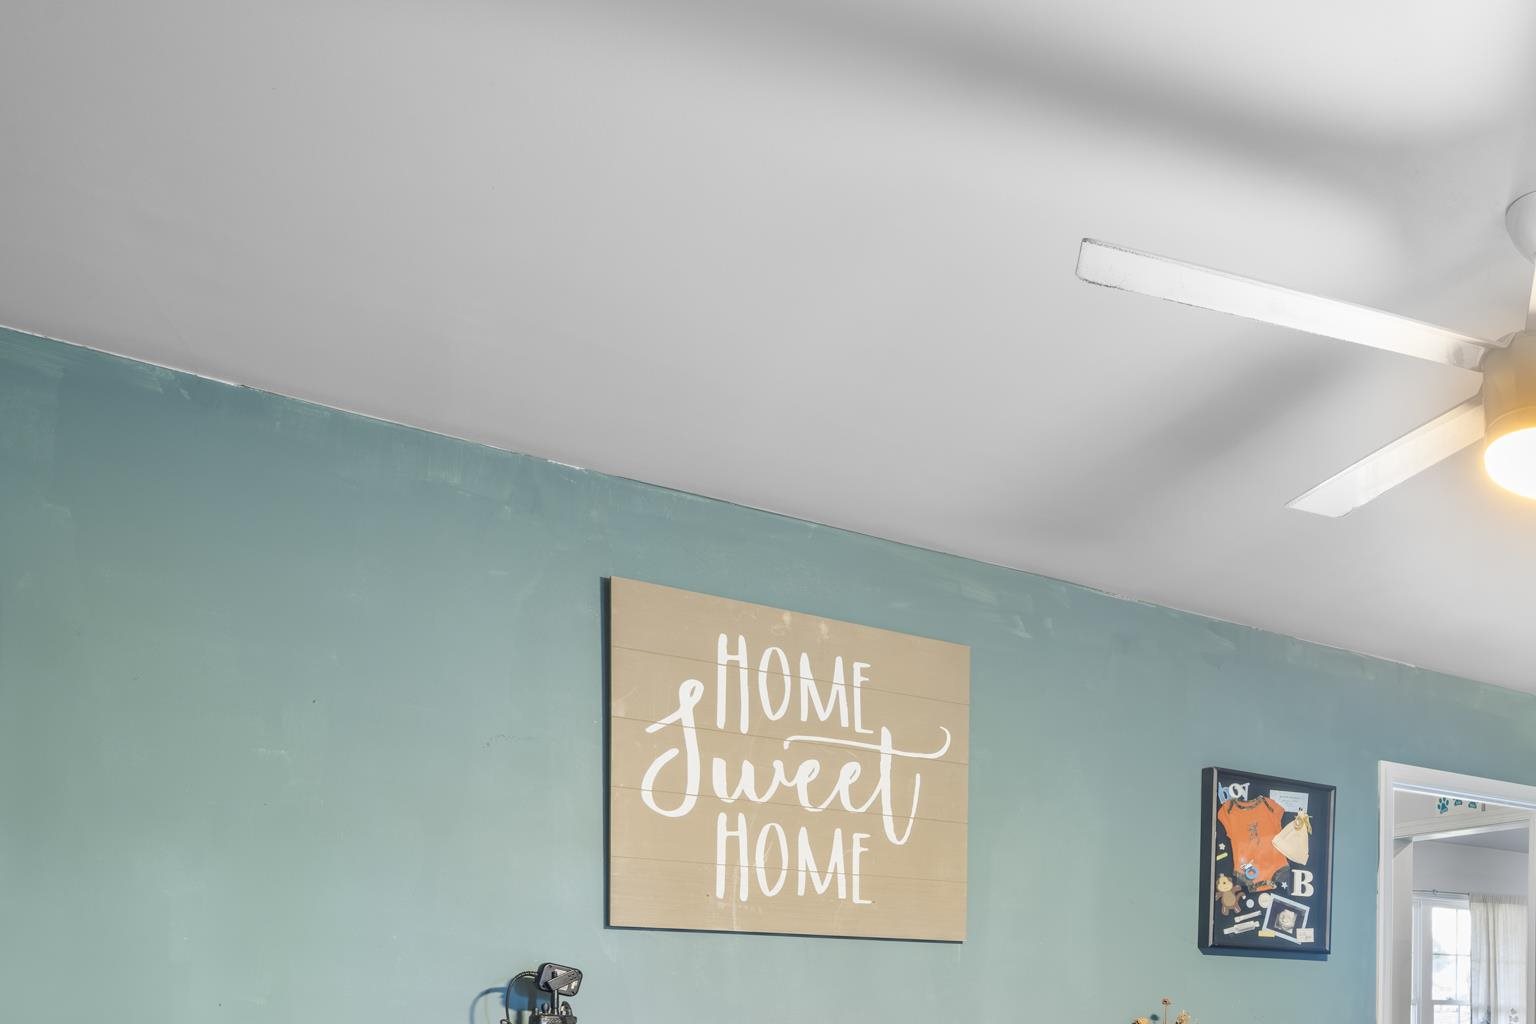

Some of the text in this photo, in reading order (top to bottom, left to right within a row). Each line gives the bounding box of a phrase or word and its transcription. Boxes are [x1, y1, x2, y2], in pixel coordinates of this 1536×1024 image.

[716, 633, 874, 734] HOME
[640, 678, 951, 845] Sweet
[715, 812, 873, 905] HOME
[1291, 869, 1315, 898] B
